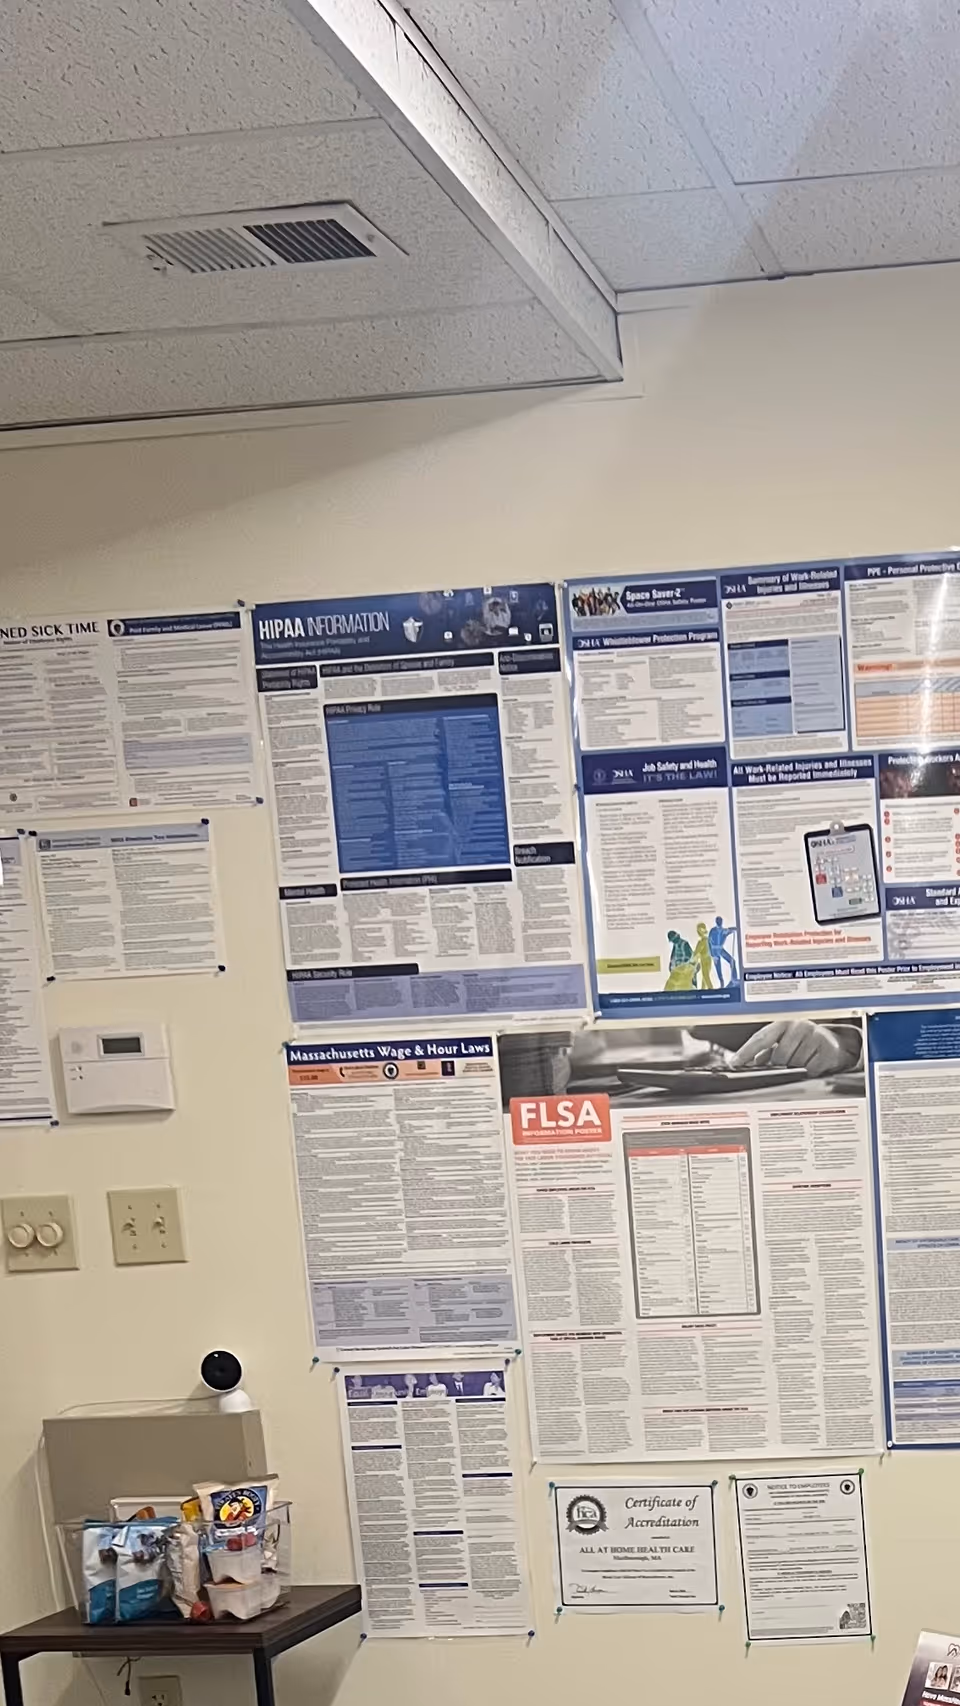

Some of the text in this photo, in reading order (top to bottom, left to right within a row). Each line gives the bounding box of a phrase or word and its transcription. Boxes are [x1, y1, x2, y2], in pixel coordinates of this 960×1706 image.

[0, 621, 100, 639] NED SICK TIME
[258, 611, 390, 640] HIPAA INFORMATION
[642, 762, 656, 774] Job
[290, 1042, 491, 1061] Massachusetts Wage & Hour Laws
[519, 1100, 601, 1129] FLSA
[624, 1494, 699, 1512] Certificate of
[623, 1515, 700, 1530] Accreditation
